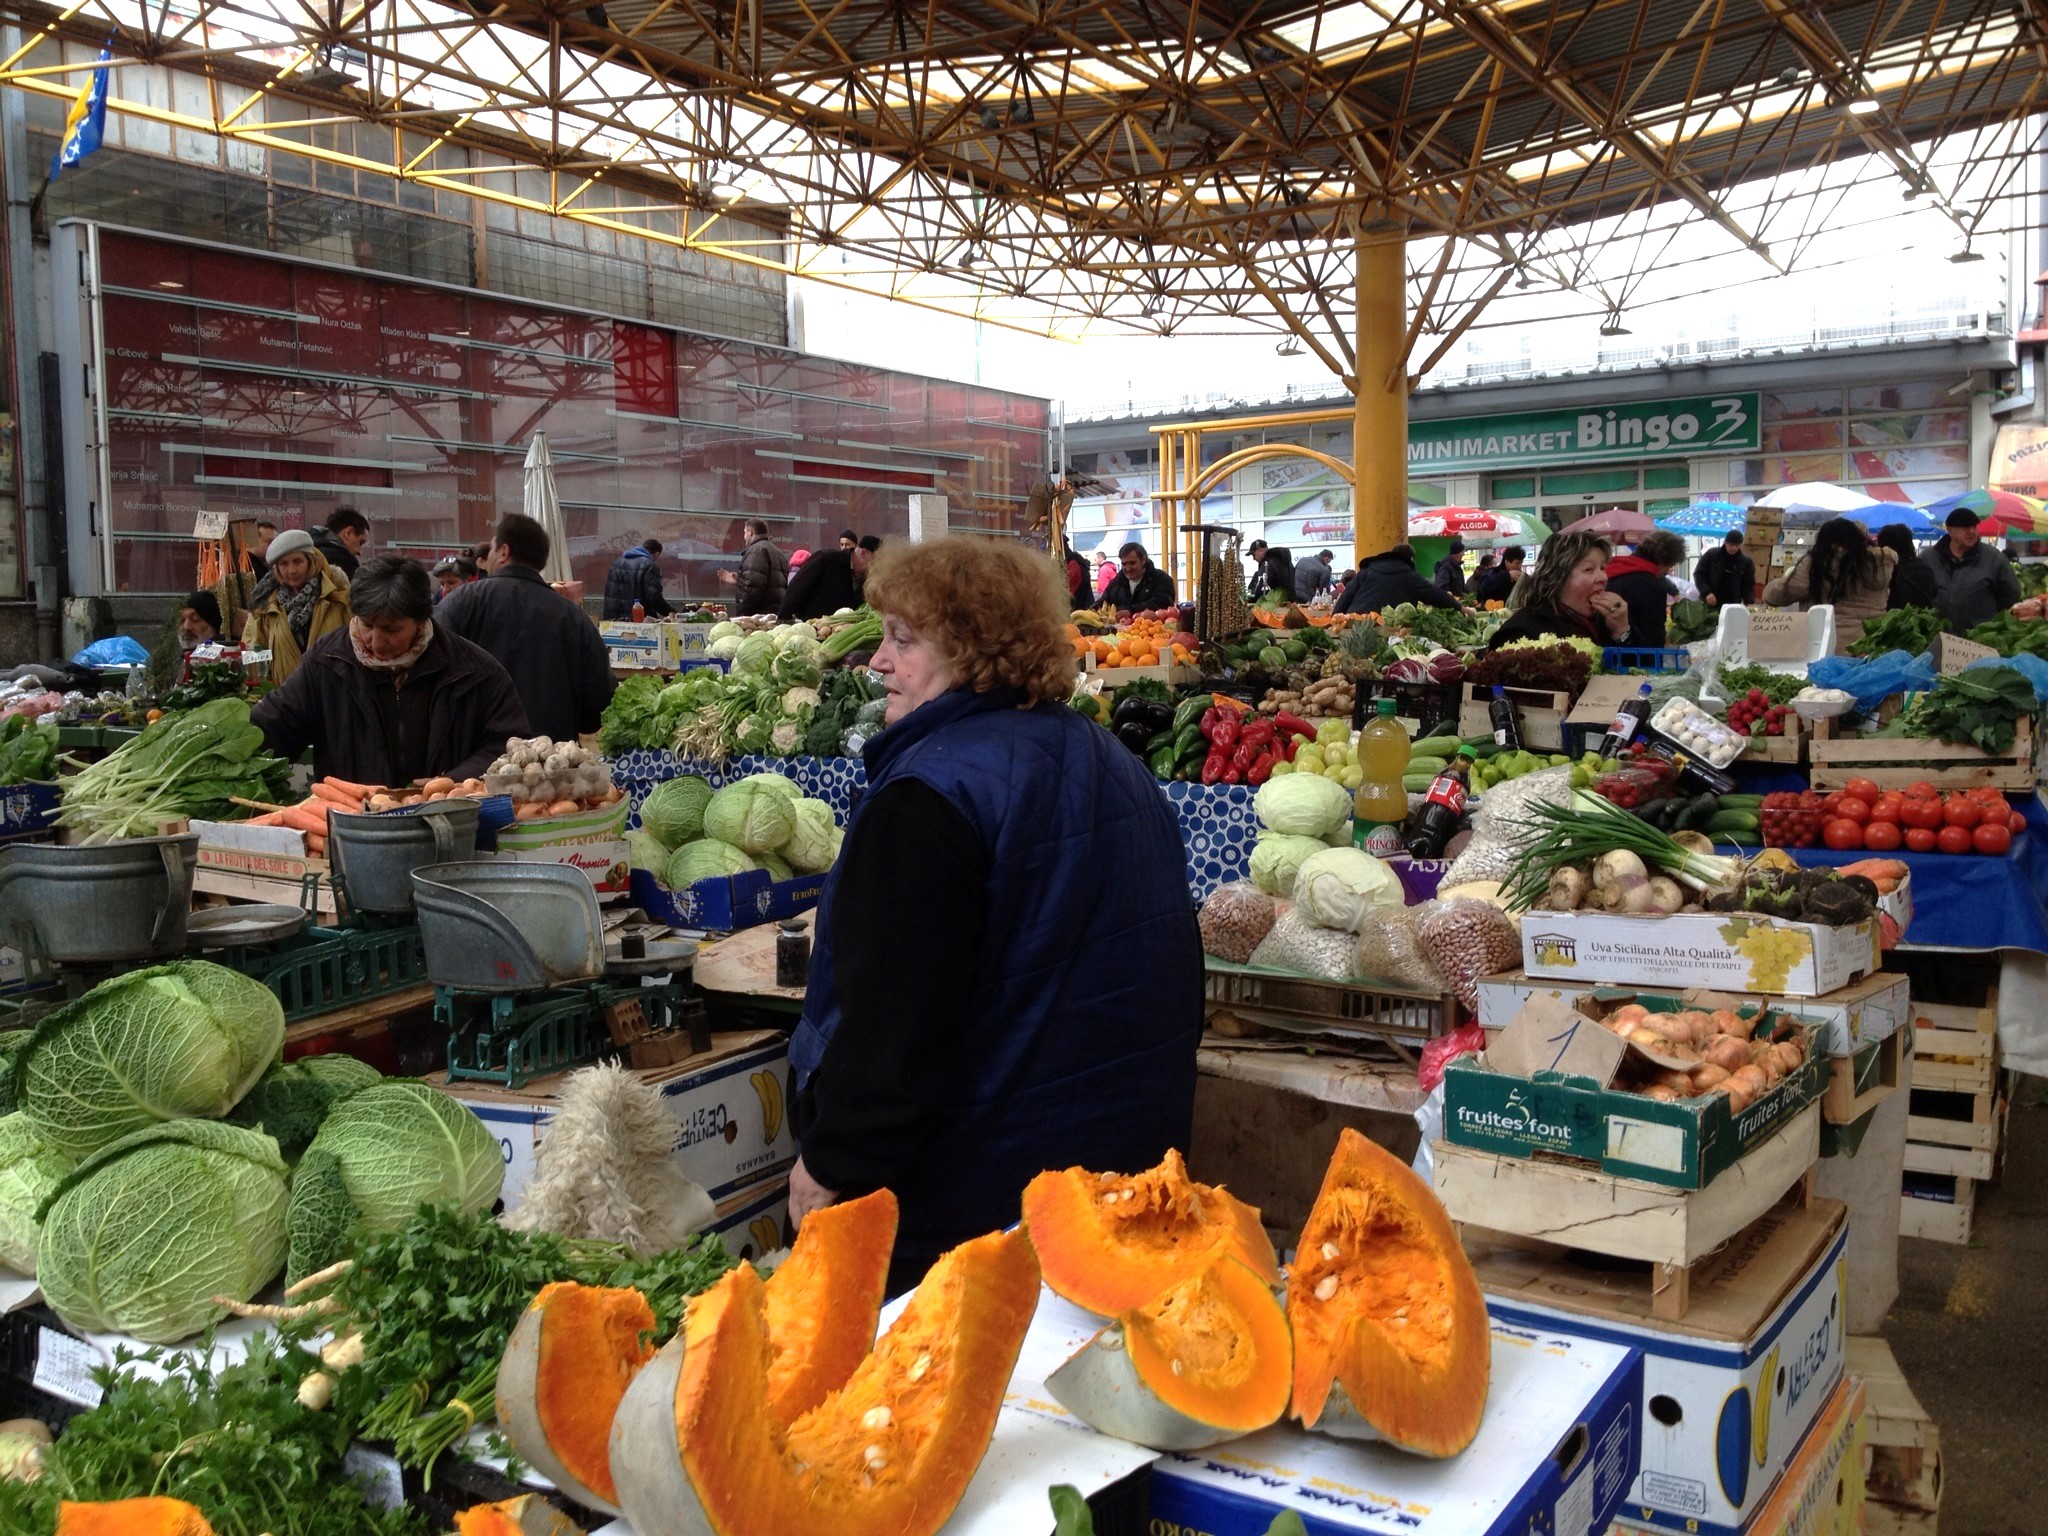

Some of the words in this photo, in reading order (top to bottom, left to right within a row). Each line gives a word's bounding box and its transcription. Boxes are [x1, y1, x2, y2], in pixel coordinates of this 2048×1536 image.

[168, 323, 197, 336] Vahida
[200, 326, 222, 339] Bešić
[321, 317, 339, 327] Nura
[340, 320, 363, 330] Odžak
[380, 326, 405, 337] Mladen
[259, 336, 296, 349] Muhamed
[299, 342, 334, 354] Fetahović
[117, 347, 149, 360] Gibović
[229, 419, 268, 431] Muhamed
[1408, 430, 1572, 461] MINIMARKET
[1577, 409, 1699, 451] Bingo
[122, 501, 164, 512] Muhamed
[1460, 521, 1489, 530] ALGIDA
[1947, 648, 1983, 660] MENTA
[214, 852, 223, 865] LA
[225, 854, 253, 870] FRUTTA
[253, 858, 268, 872] DEL
[269, 859, 289, 875] SOLE
[1591, 941, 1612, 953] Uva
[1614, 942, 1661, 957] Siciliana
[1662, 946, 1686, 958] Alta
[1688, 946, 1732, 960] Qualità
[1643, 957, 1668, 967] DELLA
[1668, 958, 1693, 969] VALLE
[1694, 960, 1711, 969] DEI
[1711, 961, 1741, 971] TEMPLI
[1738, 1097, 1780, 1142] fruites
[1781, 1080, 1806, 1108] font
[1457, 1105, 1524, 1131] fruites
[1528, 1118, 1572, 1140] font
[1460, 1121, 1483, 1131] TORRES
[1494, 1126, 1514, 1137] SEGRE
[736, 1150, 776, 1174] BANANAS
